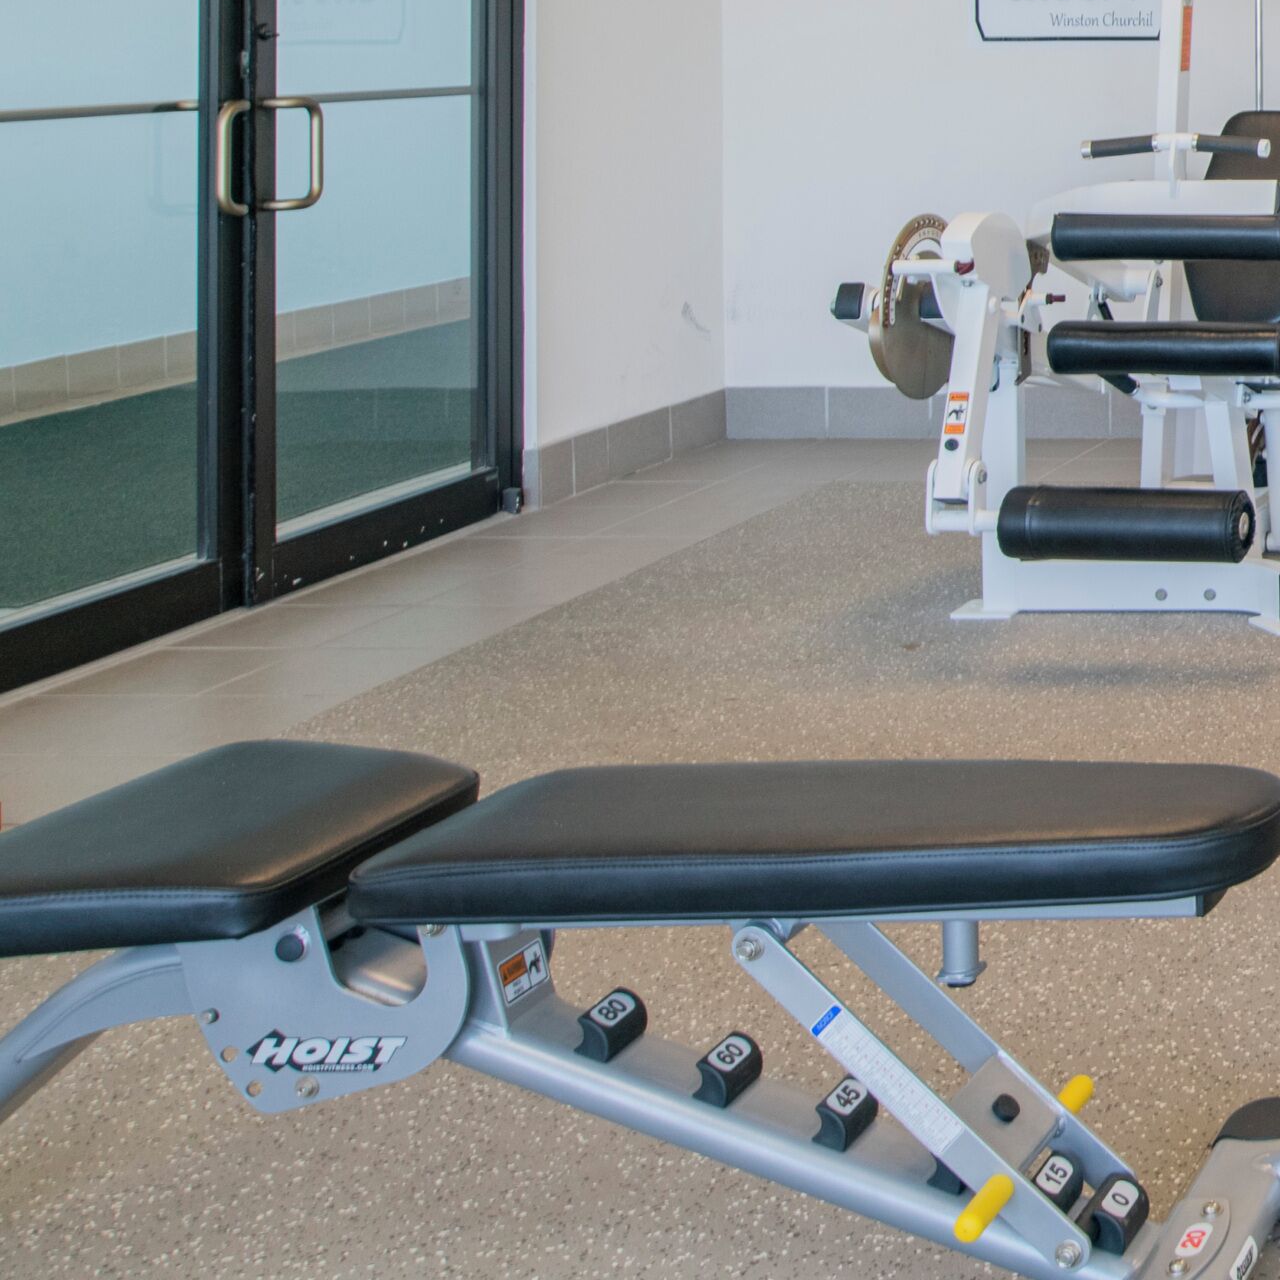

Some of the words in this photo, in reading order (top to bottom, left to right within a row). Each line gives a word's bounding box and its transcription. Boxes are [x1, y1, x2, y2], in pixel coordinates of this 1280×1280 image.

[1049, 11, 1099, 28] Winston
[1102, 10, 1153, 28] Churchil
[597, 998, 628, 1023] 80
[251, 1035, 408, 1065] HOIST
[717, 1041, 745, 1066] 60
[836, 1084, 861, 1108] 45
[1042, 1163, 1068, 1191] 15
[1109, 1191, 1129, 1210] 0
[1180, 1229, 1206, 1250] 20
